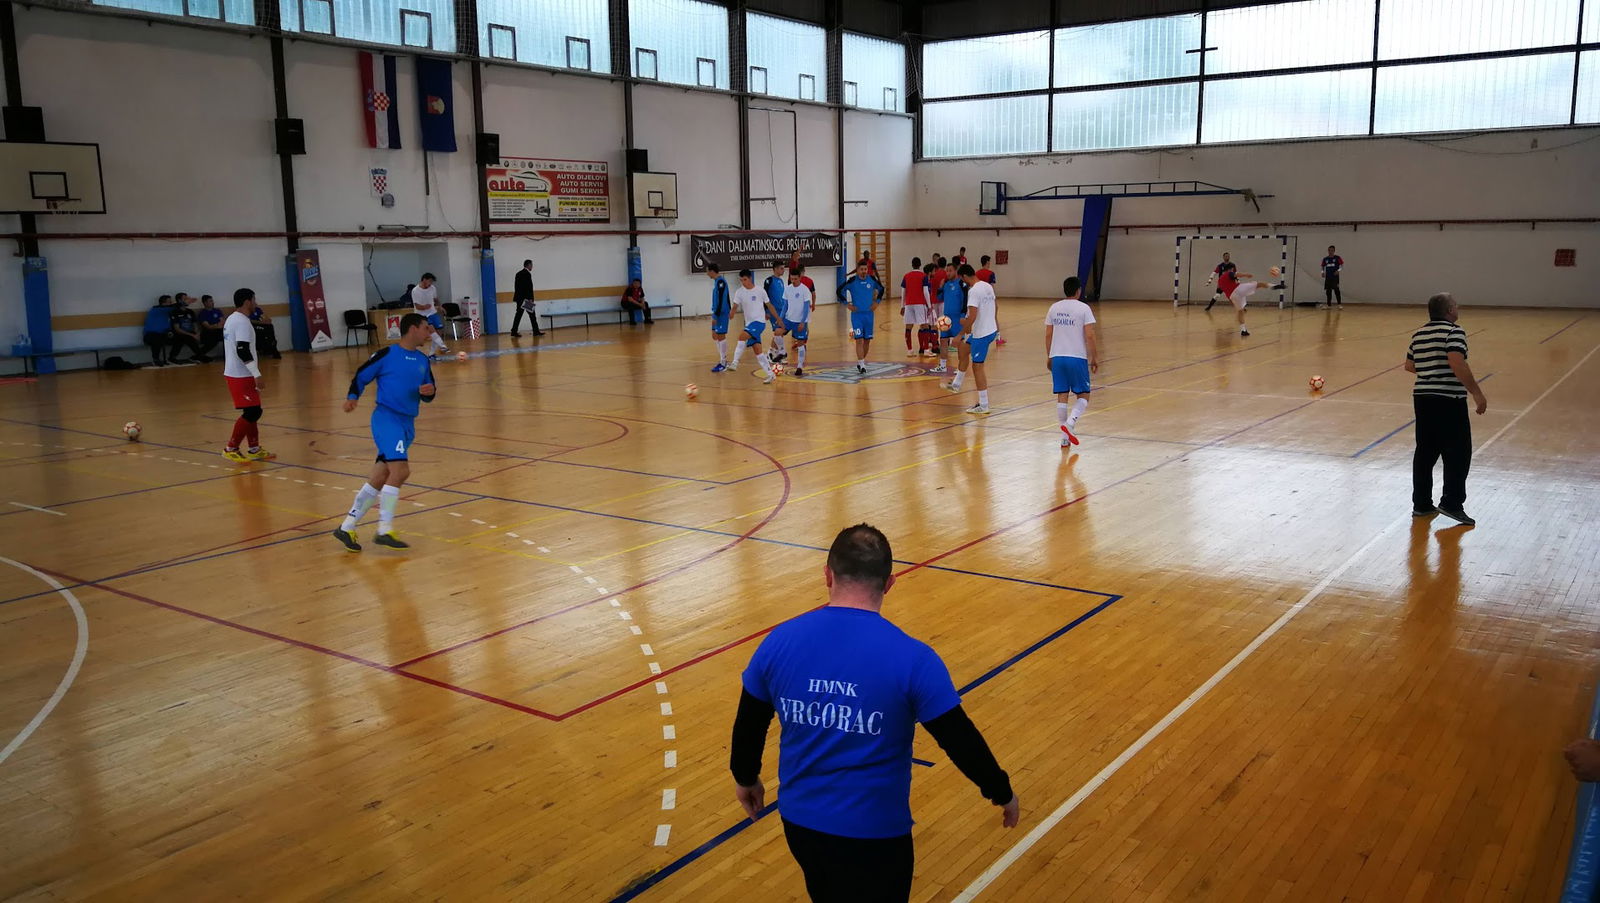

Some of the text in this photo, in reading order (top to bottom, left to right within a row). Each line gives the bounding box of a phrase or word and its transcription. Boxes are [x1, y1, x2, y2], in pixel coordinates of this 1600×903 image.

[488, 177, 525, 191] auto
[728, 238, 784, 253] DALMATINSKOG
[395, 440, 405, 454] 4
[808, 678, 859, 697] HMNK
[780, 696, 884, 735] VRGORAC
